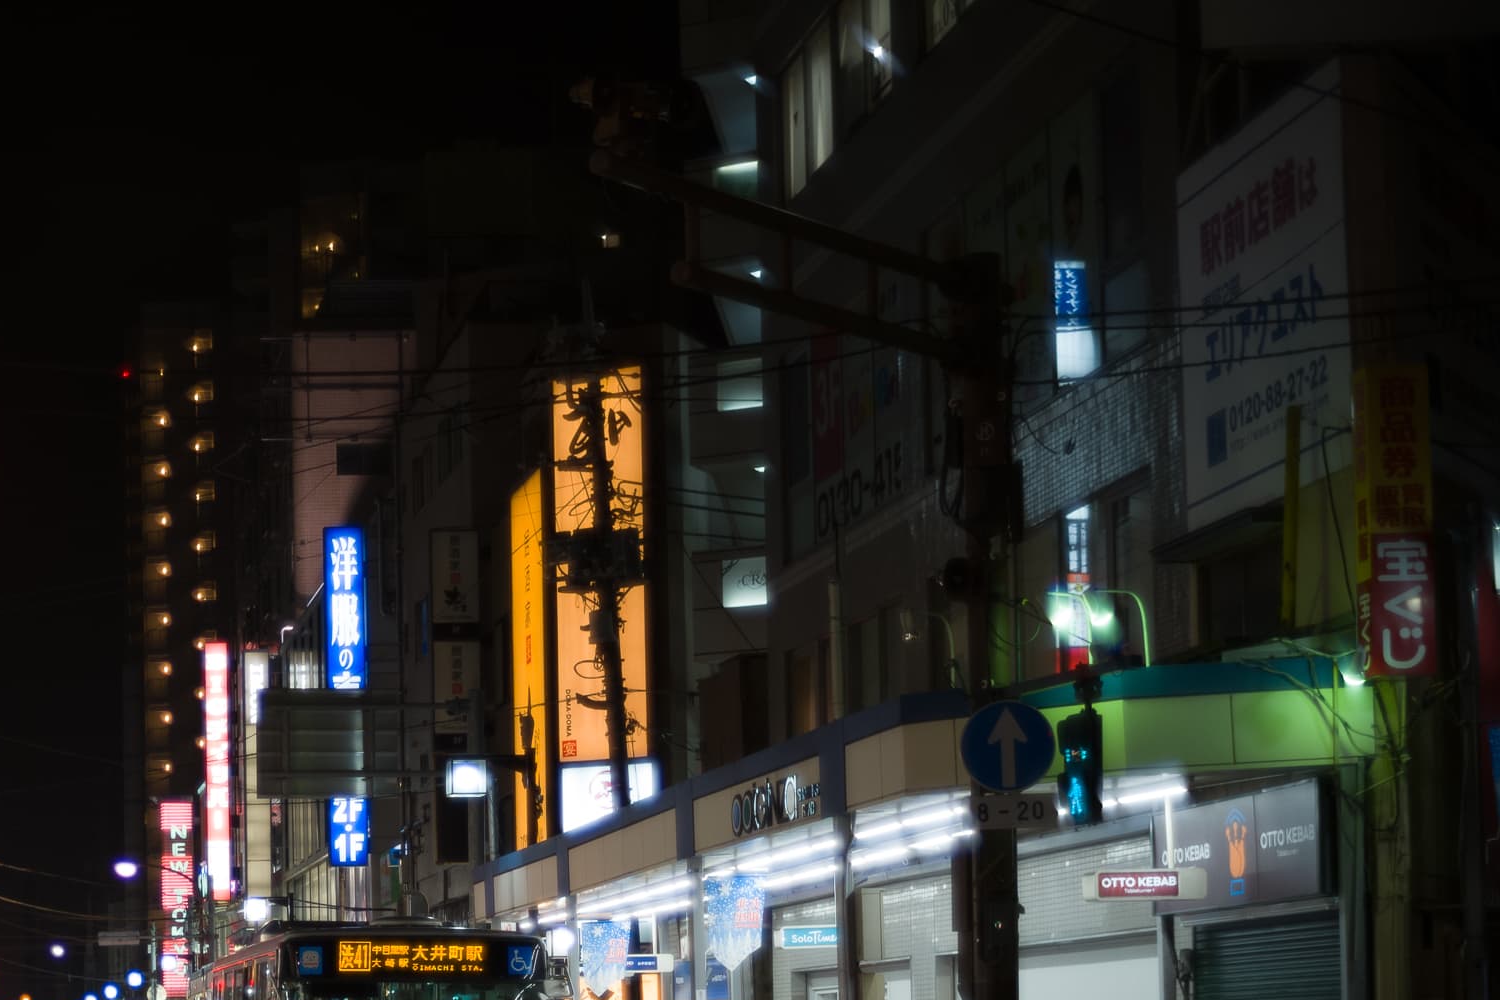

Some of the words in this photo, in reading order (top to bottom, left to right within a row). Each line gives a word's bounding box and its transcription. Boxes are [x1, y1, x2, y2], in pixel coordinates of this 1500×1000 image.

[1201, 156, 1318, 276] 駅前店舗は
[1205, 262, 1325, 382] エリアクエスト
[1229, 354, 1328, 432] 0120-88-27-22
[1376, 539, 1429, 670] 宝くじ
[333, 798, 363, 823] 2F
[170, 824, 189, 872] NEW
[335, 833, 365, 862] 1F
[1260, 830, 1285, 849] OTTO
[1285, 823, 1315, 845] KEBAB
[1162, 848, 1183, 866] OTO
[1184, 843, 1210, 862] KEBAB
[1101, 876, 1136, 889] OTTO
[1137, 875, 1177, 887] KEBAB
[341, 944, 368, 969] 渋41
[372, 958, 408, 968] 大崎駅
[412, 945, 483, 961] 大井町駅
